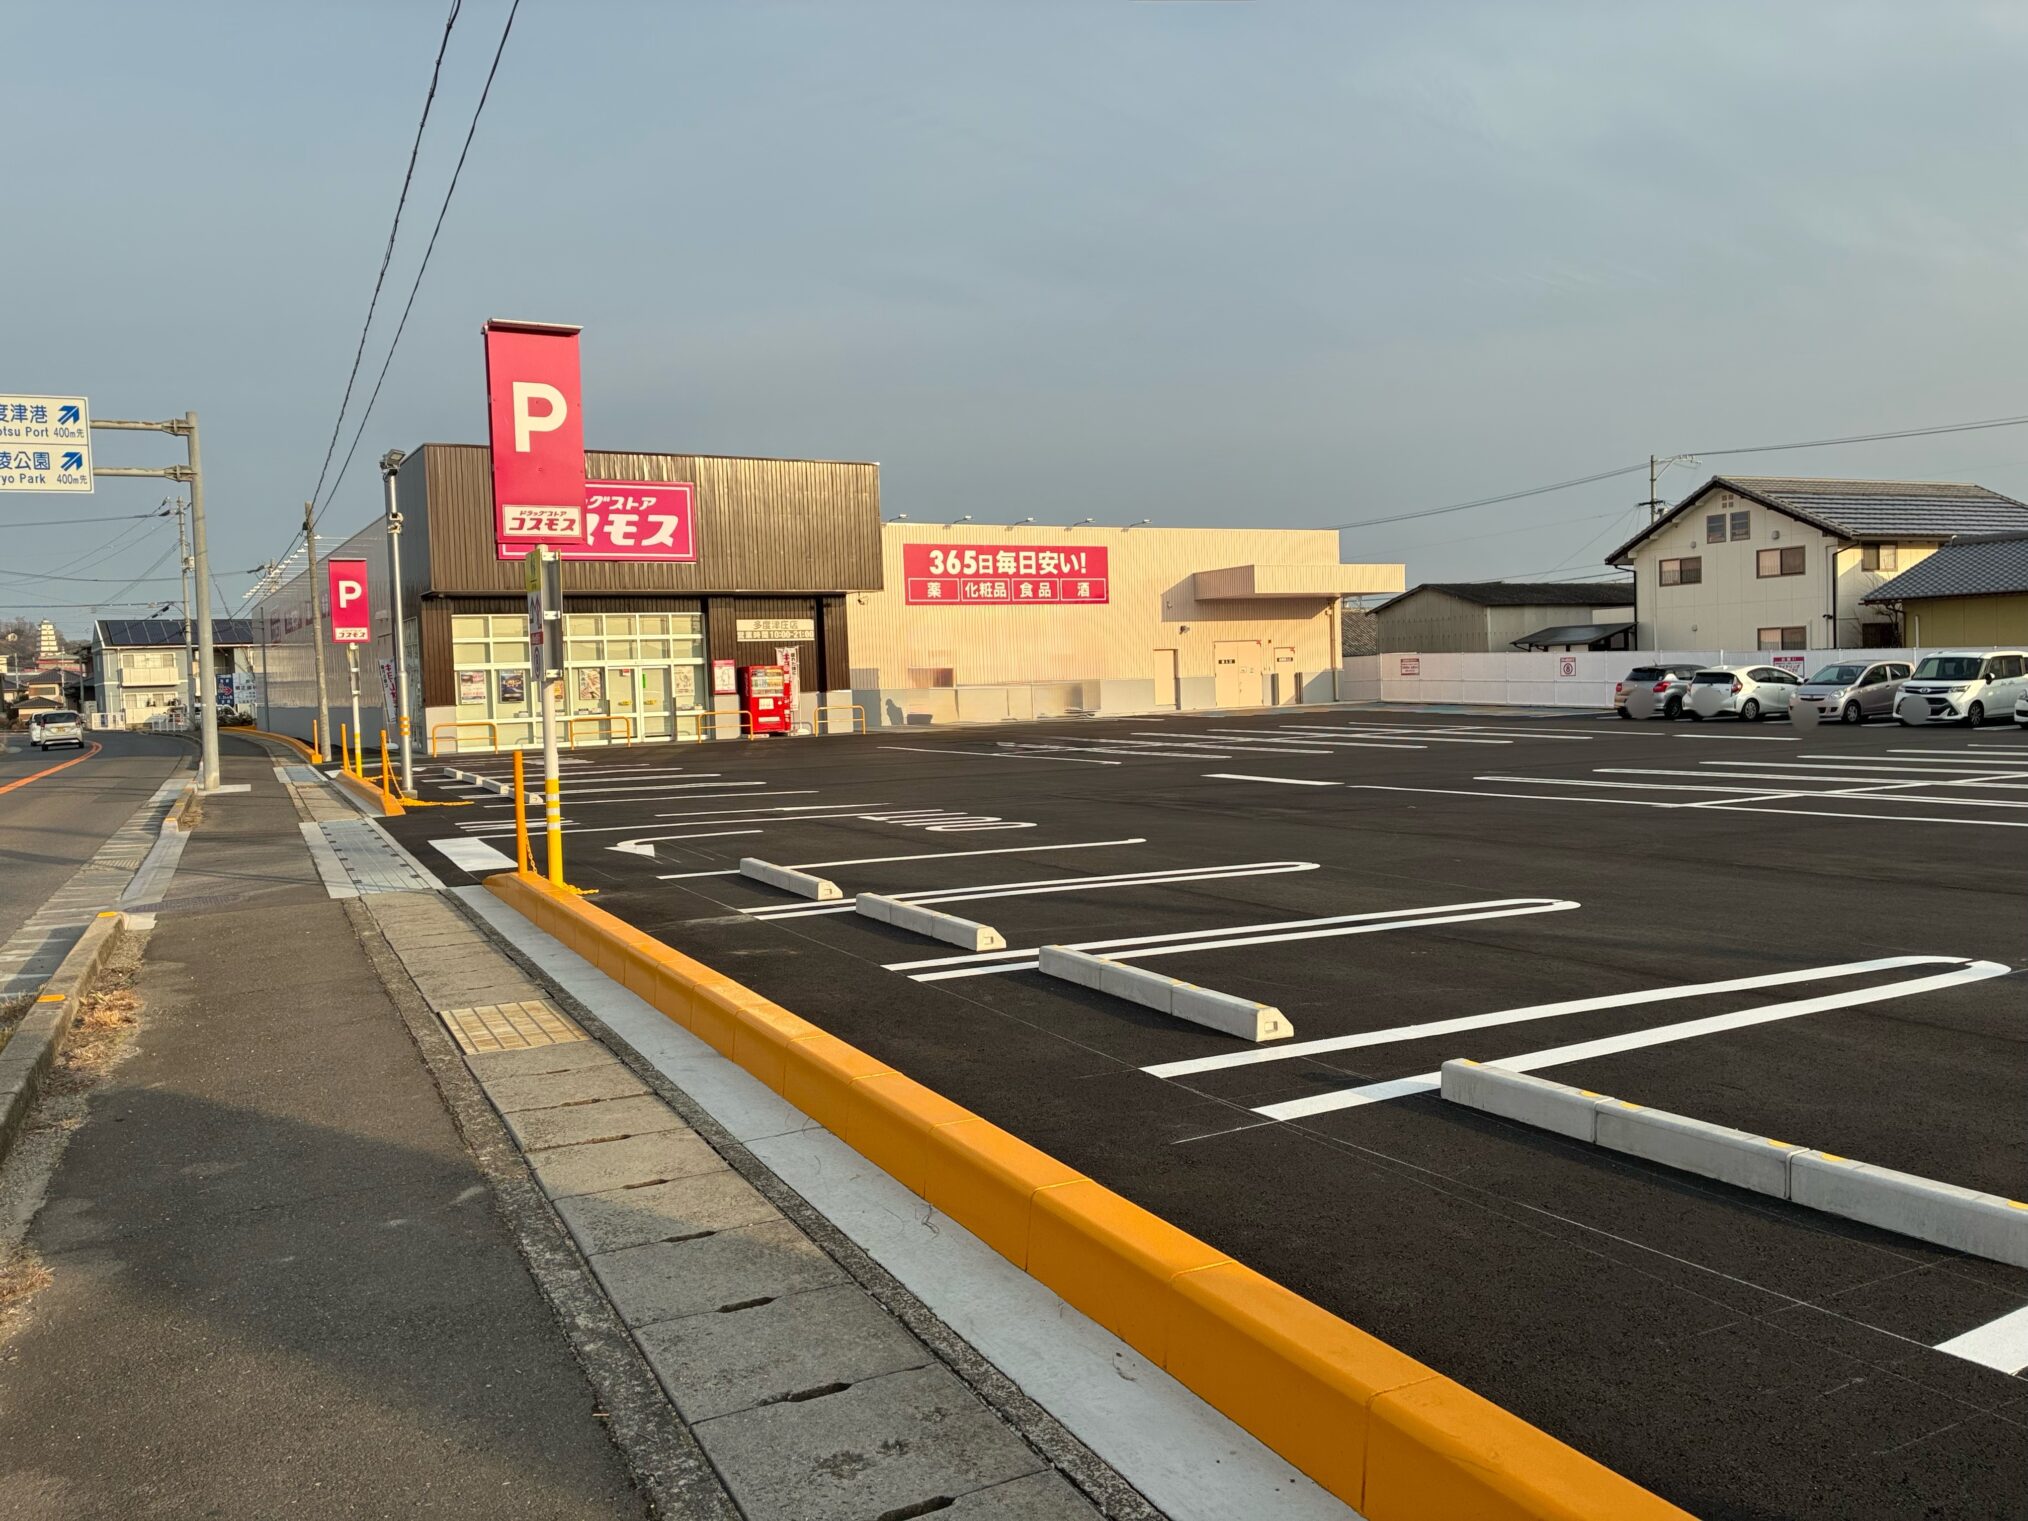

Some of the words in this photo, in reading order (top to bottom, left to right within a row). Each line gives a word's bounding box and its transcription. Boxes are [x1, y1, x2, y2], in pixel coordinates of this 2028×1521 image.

[512, 381, 568, 453] P
[25, 427, 49, 438] Port
[53, 428, 85, 438] 400m先
[19, 474, 46, 484] Park
[56, 474, 88, 485] 400m先
[586, 495, 657, 511] グストア
[519, 509, 568, 517] ドラッグストア
[509, 517, 576, 532] コスモス
[928, 549, 1088, 576] 365日毎日安い!
[338, 580, 362, 609] P
[927, 581, 942, 598] 薬
[965, 581, 1007, 598] 化粧品
[1019, 581, 1052, 598] 食品
[1077, 581, 1091, 598] 酒
